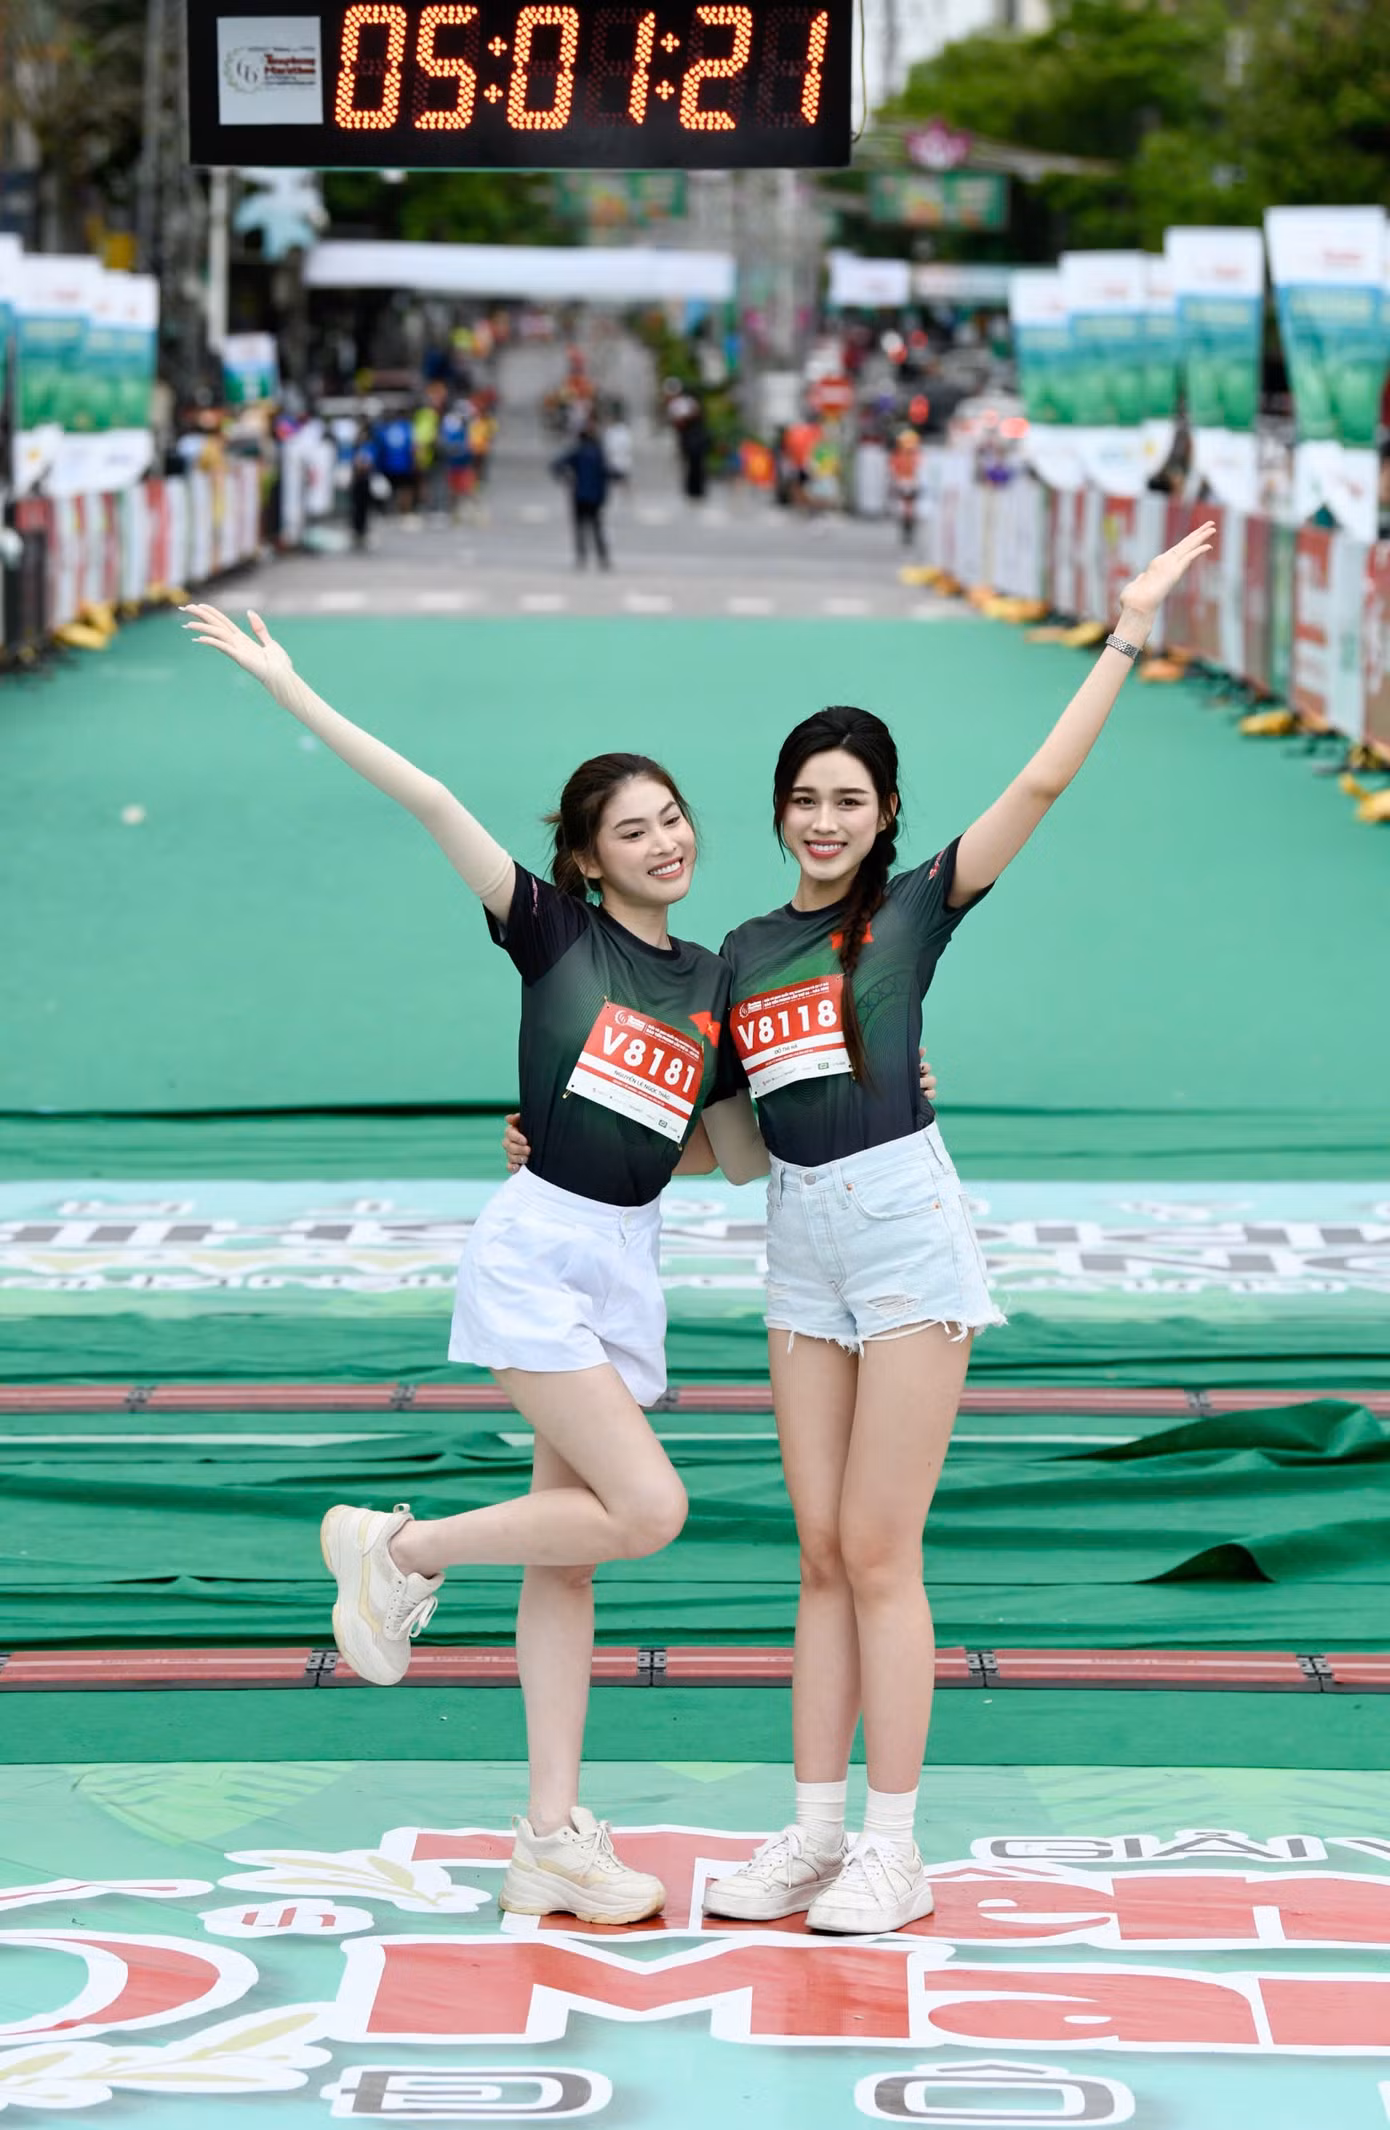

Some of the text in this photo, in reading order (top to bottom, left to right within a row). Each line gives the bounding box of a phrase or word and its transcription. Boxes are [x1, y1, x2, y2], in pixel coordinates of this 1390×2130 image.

[336, 5, 829, 130] 05:01:21
[737, 999, 838, 1050] V8118
[602, 1025, 696, 1093] V8181
[990, 1831, 1307, 1859] GIẢI
[412, 1832, 1390, 1944] Tền
